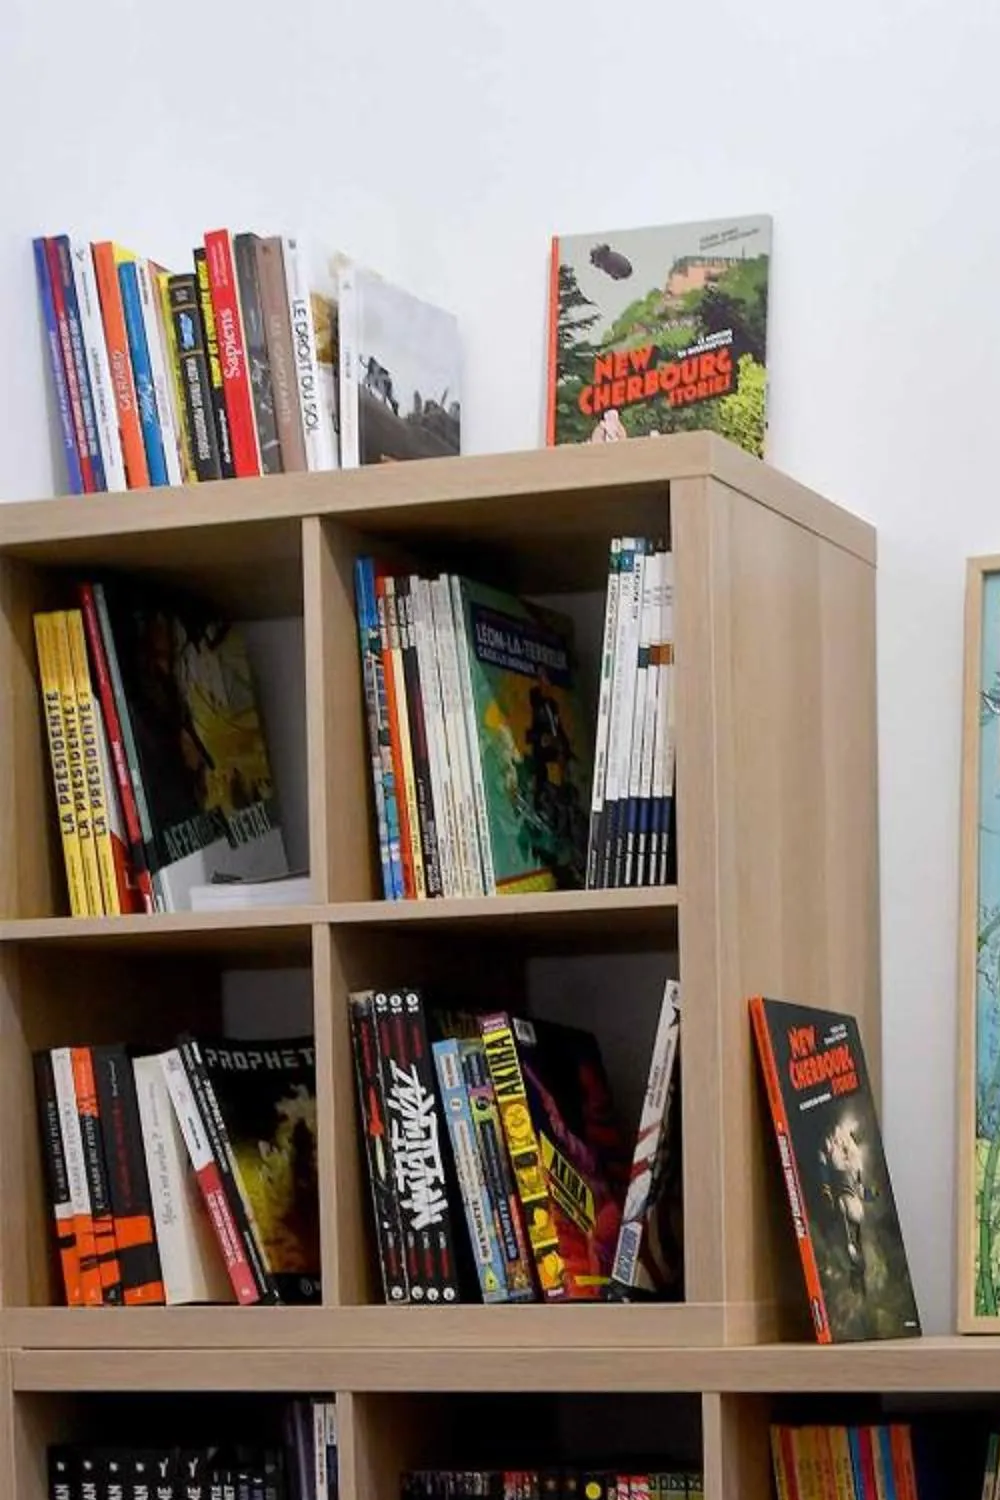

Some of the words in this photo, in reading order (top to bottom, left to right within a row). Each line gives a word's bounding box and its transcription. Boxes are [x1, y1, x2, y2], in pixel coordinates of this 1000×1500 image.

[292, 299, 307, 318] LE
[223, 307, 244, 380] Sapiens
[295, 320, 313, 373] DROIT
[594, 344, 657, 384] NEW
[301, 376, 316, 400] DU
[578, 348, 733, 415] CHERBOURG
[304, 403, 320, 435] SOL
[57, 812, 75, 836] LA
[76, 818, 91, 840] LA
[91, 816, 106, 838] LA
[487, 1030, 525, 1102] AKIRA
